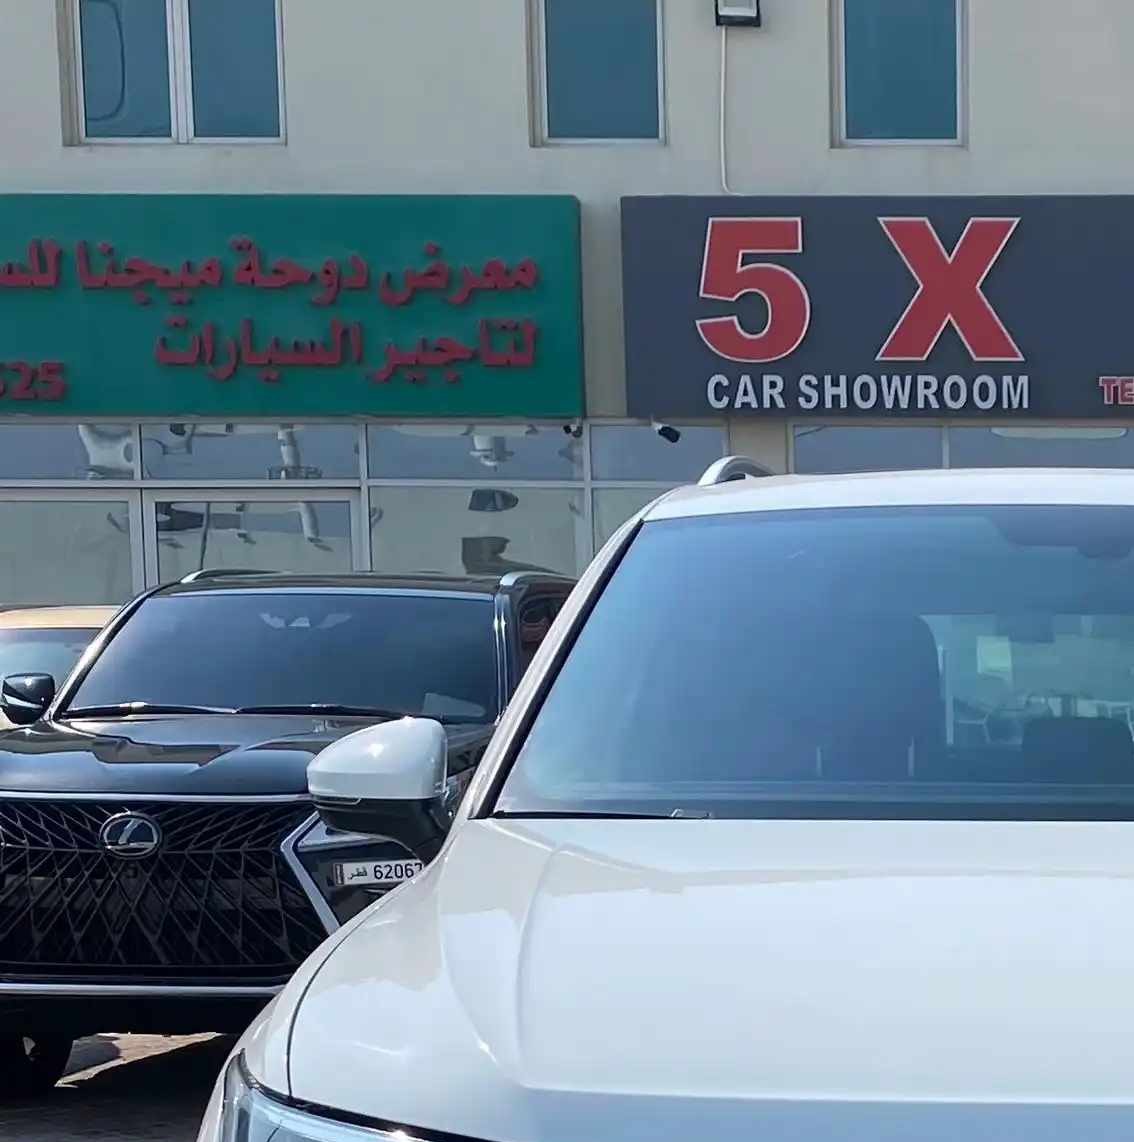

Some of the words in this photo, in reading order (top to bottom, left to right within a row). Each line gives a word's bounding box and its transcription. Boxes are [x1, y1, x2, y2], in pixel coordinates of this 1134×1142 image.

[229, 235, 368, 305] دوحة
[379, 241, 537, 306] معرض
[695, 216, 810, 362] 5
[875, 216, 1025, 361] X
[0, 359, 65, 400] 25
[155, 315, 362, 382] السيارات
[706, 373, 786, 409] CAR
[798, 374, 1030, 410] SHOWROOM
